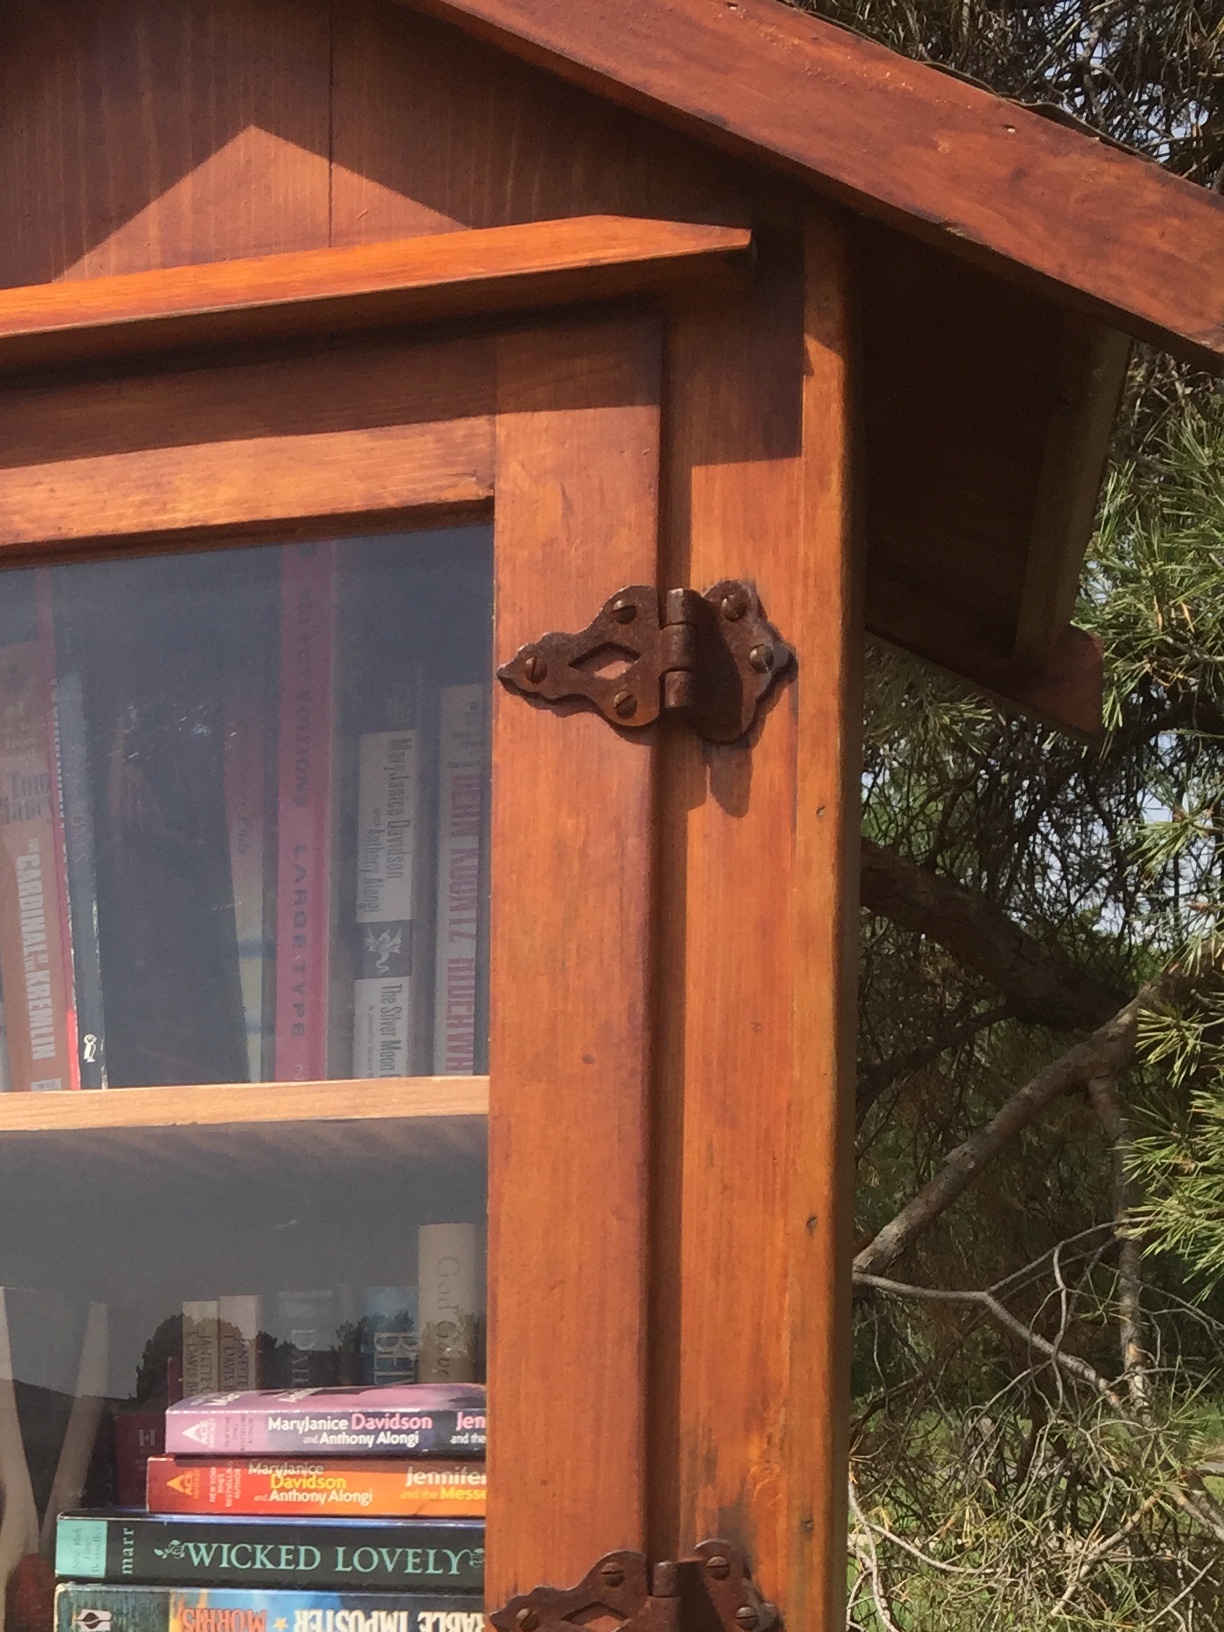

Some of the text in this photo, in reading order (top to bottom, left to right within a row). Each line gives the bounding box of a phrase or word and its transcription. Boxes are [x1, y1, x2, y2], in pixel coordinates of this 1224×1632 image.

[386, 819, 412, 880] Davidson
[16, 853, 49, 956] CARDINAL
[292, 844, 308, 948] LARGE
[291, 964, 307, 1038] TYPE
[380, 983, 403, 1006] The
[26, 969, 56, 1060] KREMLIN
[380, 1006, 403, 1038] Silver
[379, 1038, 402, 1073] Moon
[437, 1255, 460, 1311] God
[268, 1412, 433, 1434] MaryJanice Davidson
[456, 1411, 486, 1431] Jen
[319, 1431, 375, 1449] Anthony
[376, 1430, 420, 1449] Alongi
[450, 1432, 486, 1444] and the
[248, 1460, 325, 1477] MaryJanice
[270, 1473, 347, 1490] Davidson
[268, 1488, 327, 1506] Anthony
[329, 1488, 374, 1507] Alongi
[121, 1527, 135, 1576] marr
[184, 1542, 472, 1576] WICKED LOVELY
